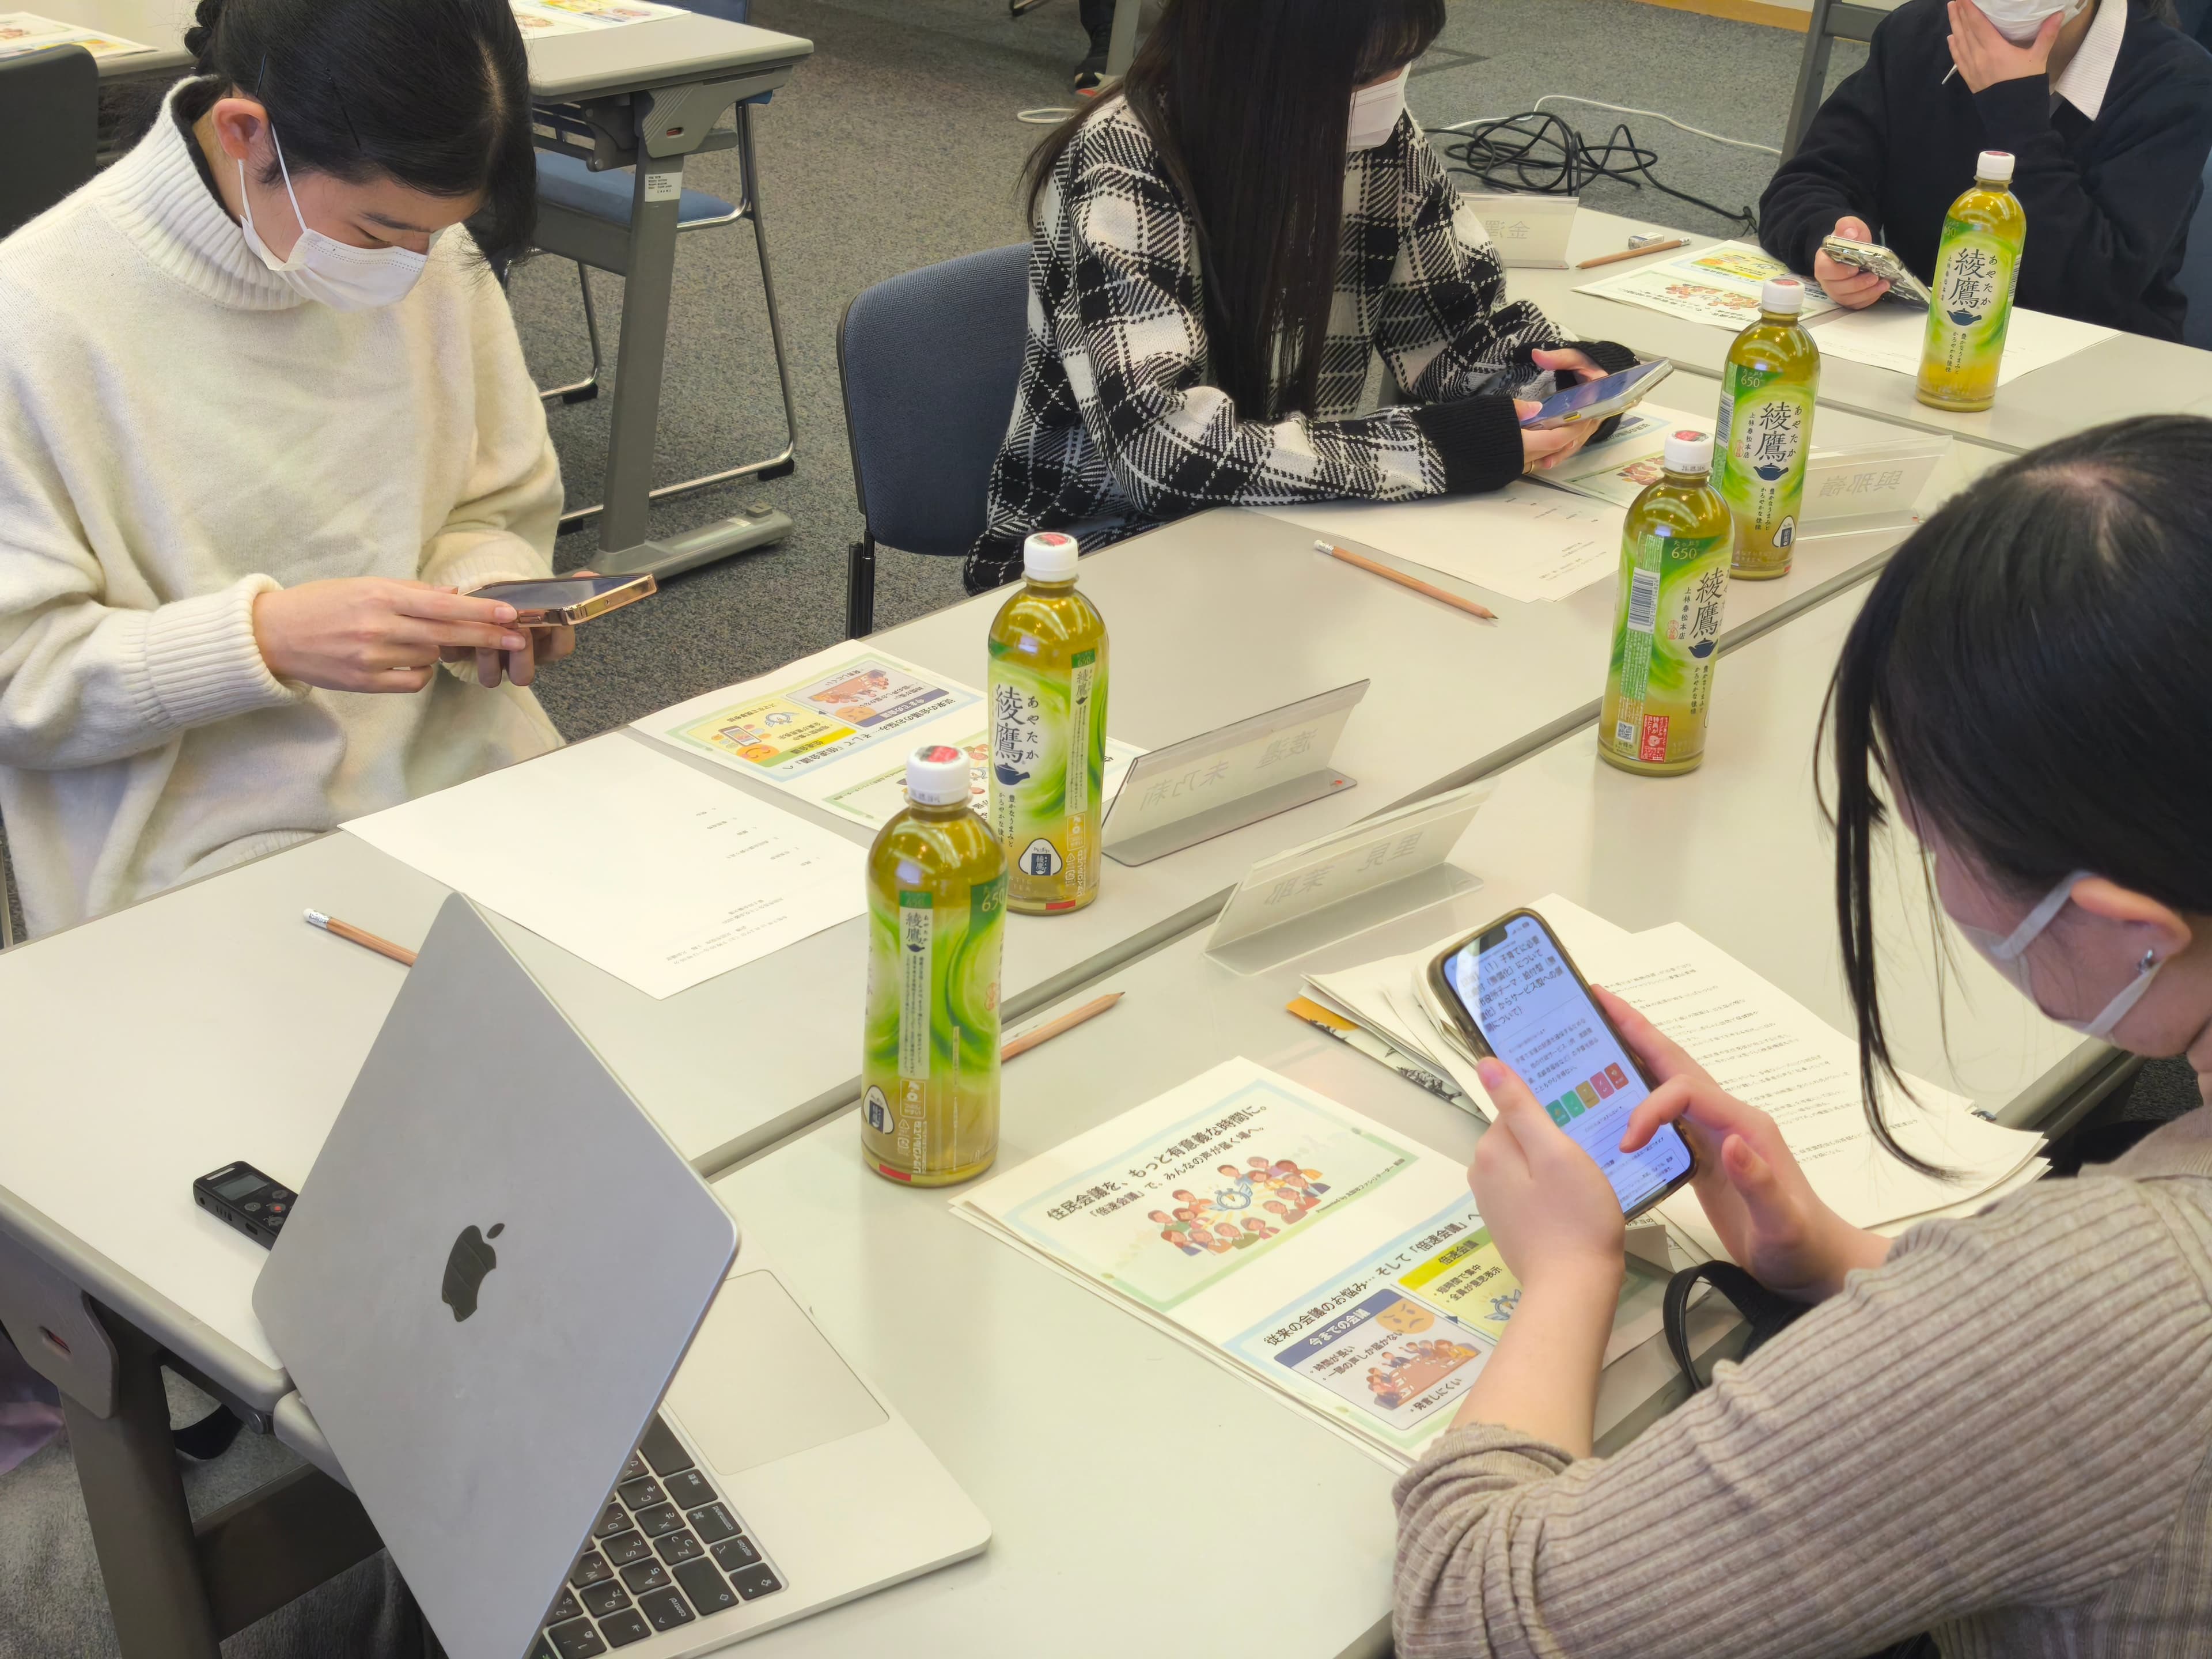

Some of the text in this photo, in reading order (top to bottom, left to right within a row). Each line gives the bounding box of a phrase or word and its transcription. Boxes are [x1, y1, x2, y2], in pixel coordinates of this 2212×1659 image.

[1948, 248, 1986, 308] 綾鷹
[1980, 255, 1998, 306] あやたか
[1741, 375, 1760, 388] 650
[1754, 401, 1792, 463] 綾鷹
[1787, 405, 1802, 458] あやたか
[1671, 547, 1698, 560] 650
[1689, 566, 1724, 639] 綾鷹
[994, 683, 1026, 764] 綾鷹
[1026, 695, 1039, 760] あやたか
[905, 912, 925, 945] 綾鷹
[1437, 1239, 1480, 1266] 倍速会議
[1308, 1309, 1372, 1347] 今までの会議
[668, 1597, 687, 1617] control
